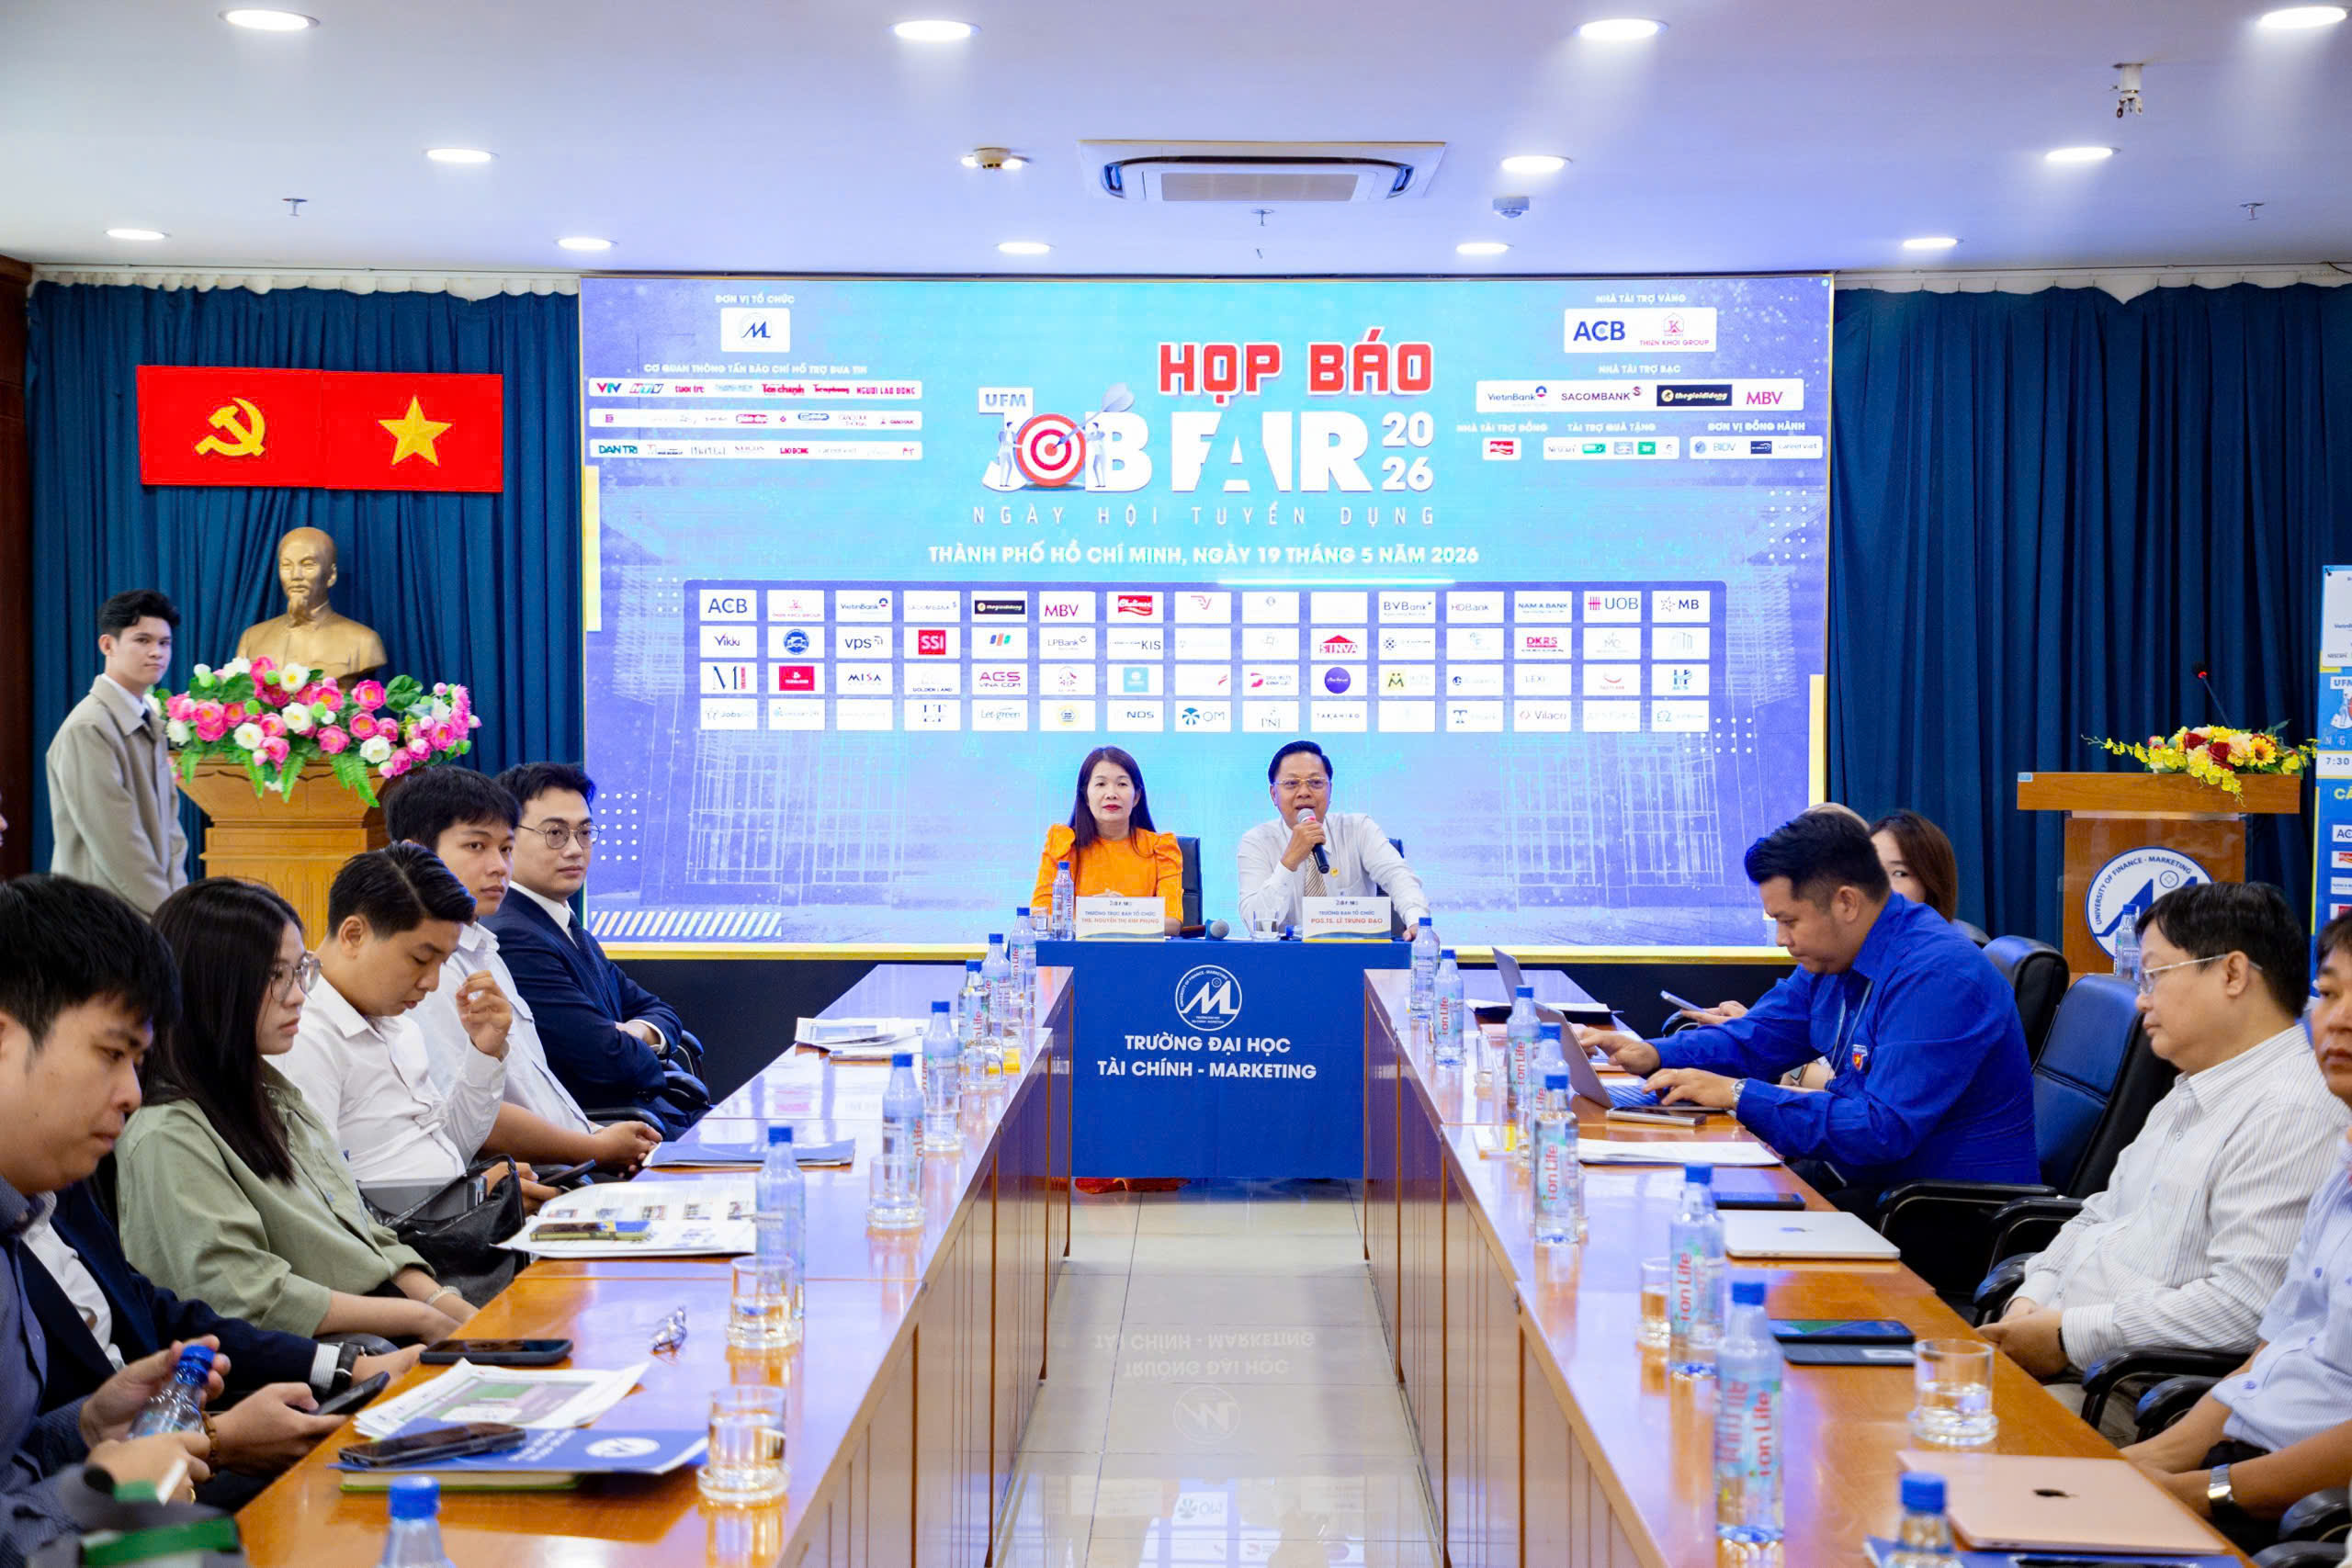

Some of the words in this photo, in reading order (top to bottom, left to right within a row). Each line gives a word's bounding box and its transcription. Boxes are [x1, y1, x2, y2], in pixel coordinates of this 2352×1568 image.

[767, 292, 795, 304] CHỨC
[1596, 293, 1616, 304] NHÀ
[1636, 293, 1657, 305] TRỢ
[1657, 293, 1687, 304] VÀNG
[1573, 321, 1626, 342] ACB
[1159, 341, 1283, 405] HỌP
[1308, 326, 1434, 396] BÁO
[597, 383, 622, 393] VTV
[985, 392, 1028, 408] UFM
[1487, 392, 1536, 401] VietinBank
[1561, 392, 1631, 401] SACOMBANK
[1746, 391, 1783, 405] MBV
[1171, 411, 1374, 492] FAIR
[1381, 411, 1435, 448] 20
[1381, 456, 1435, 492] 26
[974, 501, 1064, 525] NGÀY
[1098, 502, 1159, 528] HỘI
[1192, 498, 1306, 525] TUYỂN
[1340, 504, 1434, 528] DỤNG
[928, 540, 997, 563] THÀNH
[1002, 538, 1045, 563] PHỐ
[1050, 537, 1081, 564] HỒ
[1087, 542, 1125, 564] CHÍ
[1128, 546, 1188, 567] MINH,
[1193, 542, 1250, 564] NGÀY
[1256, 546, 1282, 564] 19
[1285, 541, 1357, 564] THÁNG
[1360, 547, 1374, 564] 5
[1379, 542, 1426, 564] NĂM
[1430, 547, 1480, 564] 2026
[708, 598, 748, 614] ACB
[1045, 604, 1080, 617] MBV
[1604, 597, 1639, 610] UOB
[1679, 599, 1700, 610] MB
[844, 637, 872, 649] vps
[921, 635, 944, 650] SSI
[1141, 640, 1161, 650] KIS
[848, 673, 882, 682] MISA
[979, 671, 1021, 682] AGS
[2325, 757, 2349, 766] 7:30
[2094, 884, 2107, 925] UNIVERSITY
[2105, 873, 2114, 885] OF
[2111, 856, 2143, 875] FINANCE
[2148, 855, 2192, 875] MARKETING
[1440, 996, 1449, 1015] Life
[1125, 1031, 1203, 1052] TRƯỜNG
[1208, 1036, 1241, 1055] ĐẠI
[1247, 1037, 1291, 1056] HỌC
[1514, 1041, 1526, 1063] Life
[1097, 1056, 1125, 1077] TÀI
[1131, 1057, 1193, 1077] CHÍNH
[1209, 1062, 1317, 1079] MARKETING
[1535, 1088, 1547, 1111] Life
[1544, 1144, 1558, 1171] Life
[1677, 1253, 1691, 1285] Life
[1751, 1391, 1771, 1433] Life
